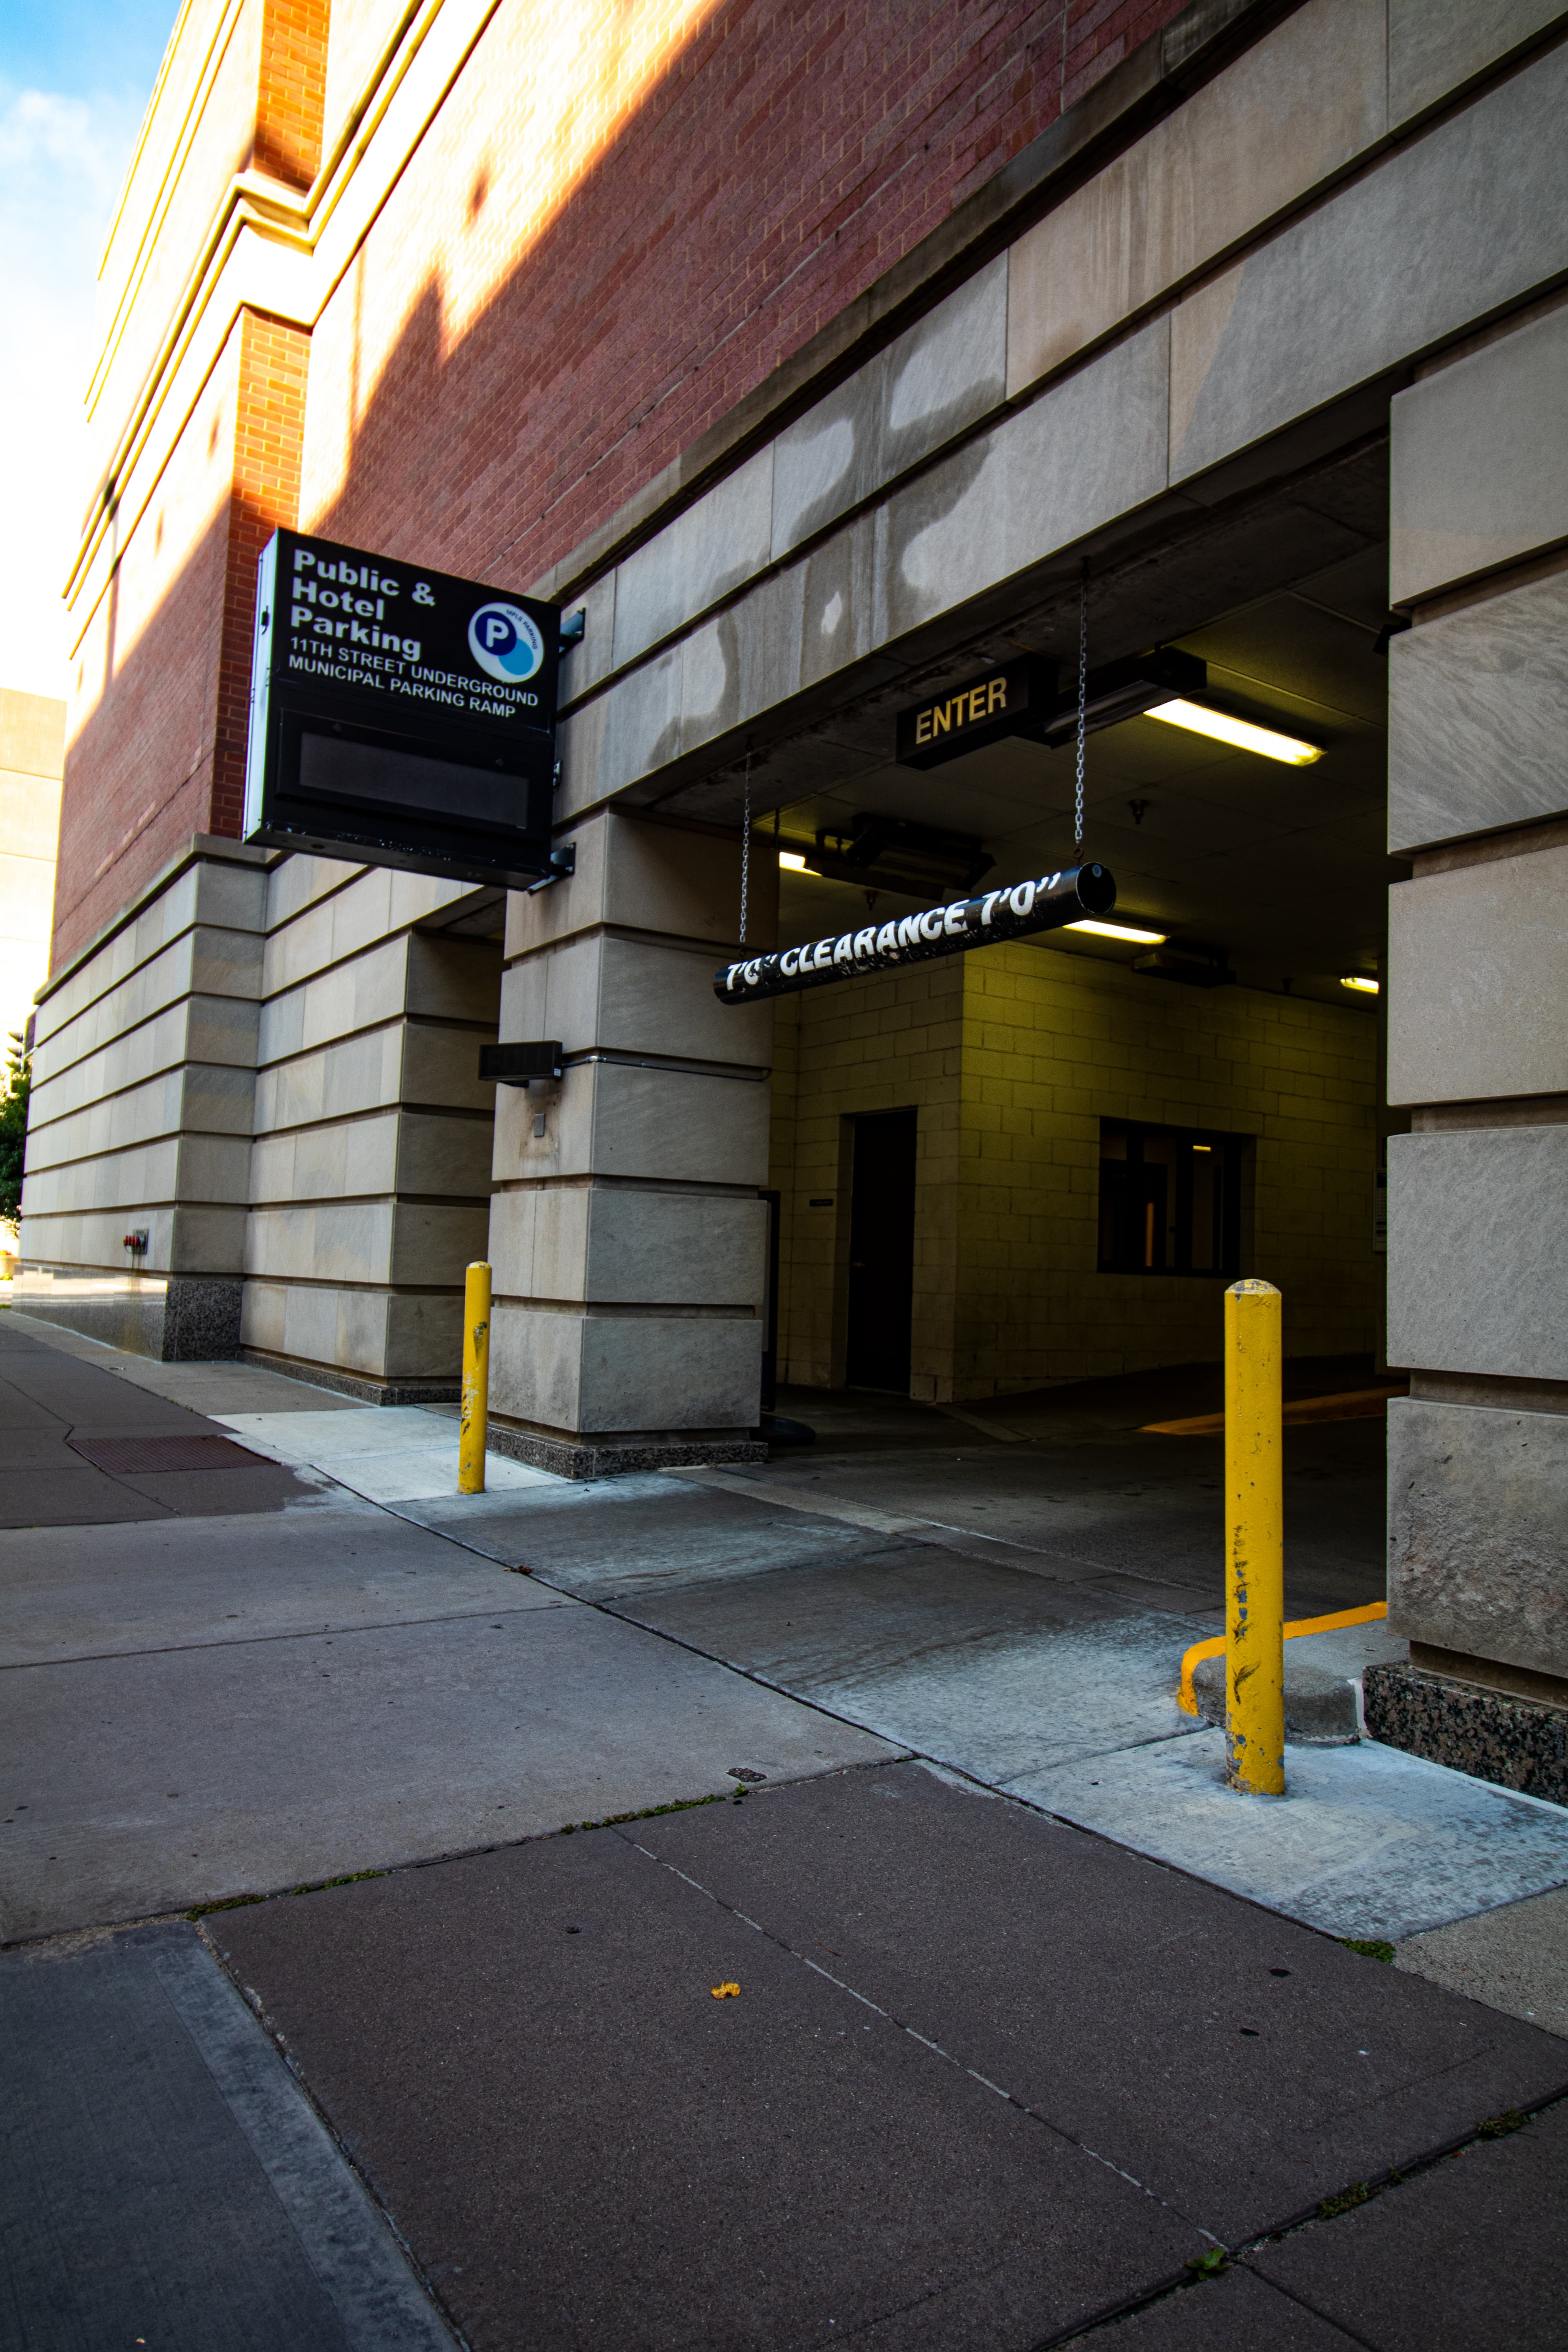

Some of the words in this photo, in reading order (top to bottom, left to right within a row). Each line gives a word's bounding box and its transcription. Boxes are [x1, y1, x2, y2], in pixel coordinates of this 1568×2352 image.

[292, 576, 385, 621] Hotel
[293, 548, 400, 597] Public
[411, 581, 437, 607] &
[290, 604, 421, 662] Parking
[485, 617, 510, 648] P
[506, 609, 523, 622] MPLS
[522, 621, 538, 650] PARKING
[288, 653, 385, 689] MUNICIPAL
[390, 677, 466, 707] PARKING
[469, 696, 516, 718] RAMP
[290, 636, 333, 658] 11TH
[338, 647, 406, 675] STREET
[410, 664, 539, 707] UNDERGROUND
[915, 676, 1007, 744] ENTER
[780, 899, 968, 978] CLEARANCE
